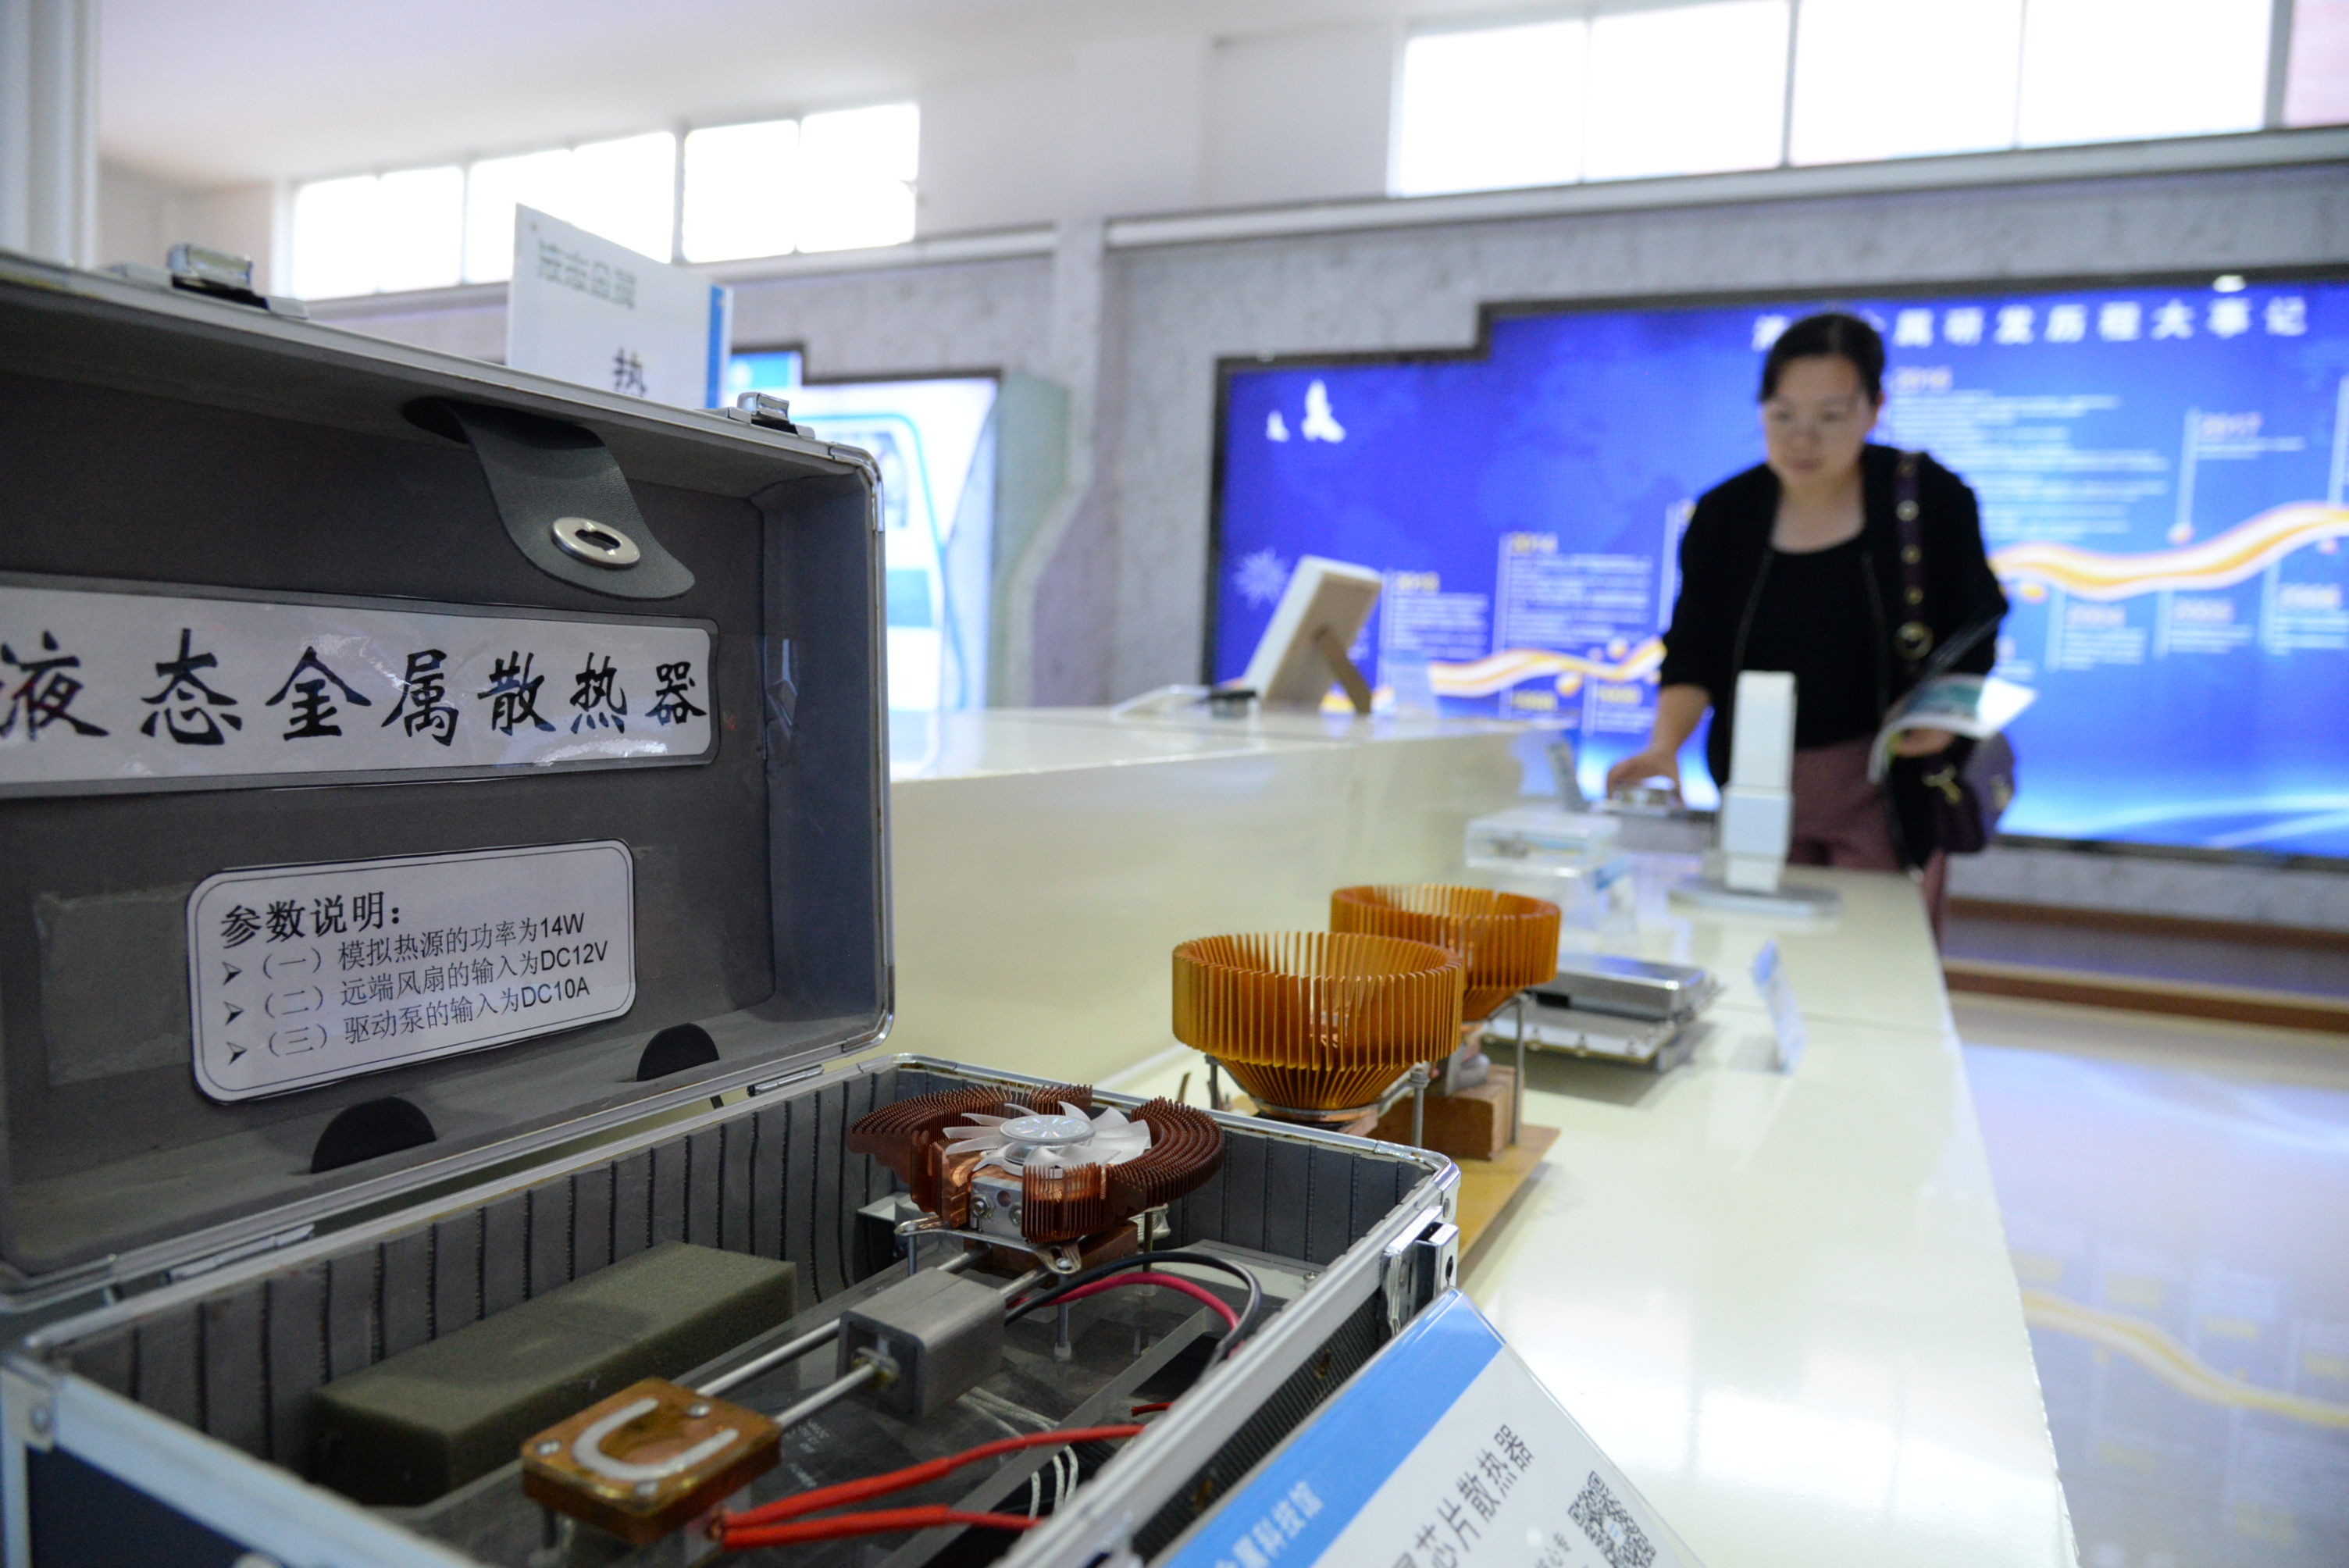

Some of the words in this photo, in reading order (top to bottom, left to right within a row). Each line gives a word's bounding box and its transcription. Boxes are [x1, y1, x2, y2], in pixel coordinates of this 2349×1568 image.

[0, 627, 708, 747] 液态金属散热器
